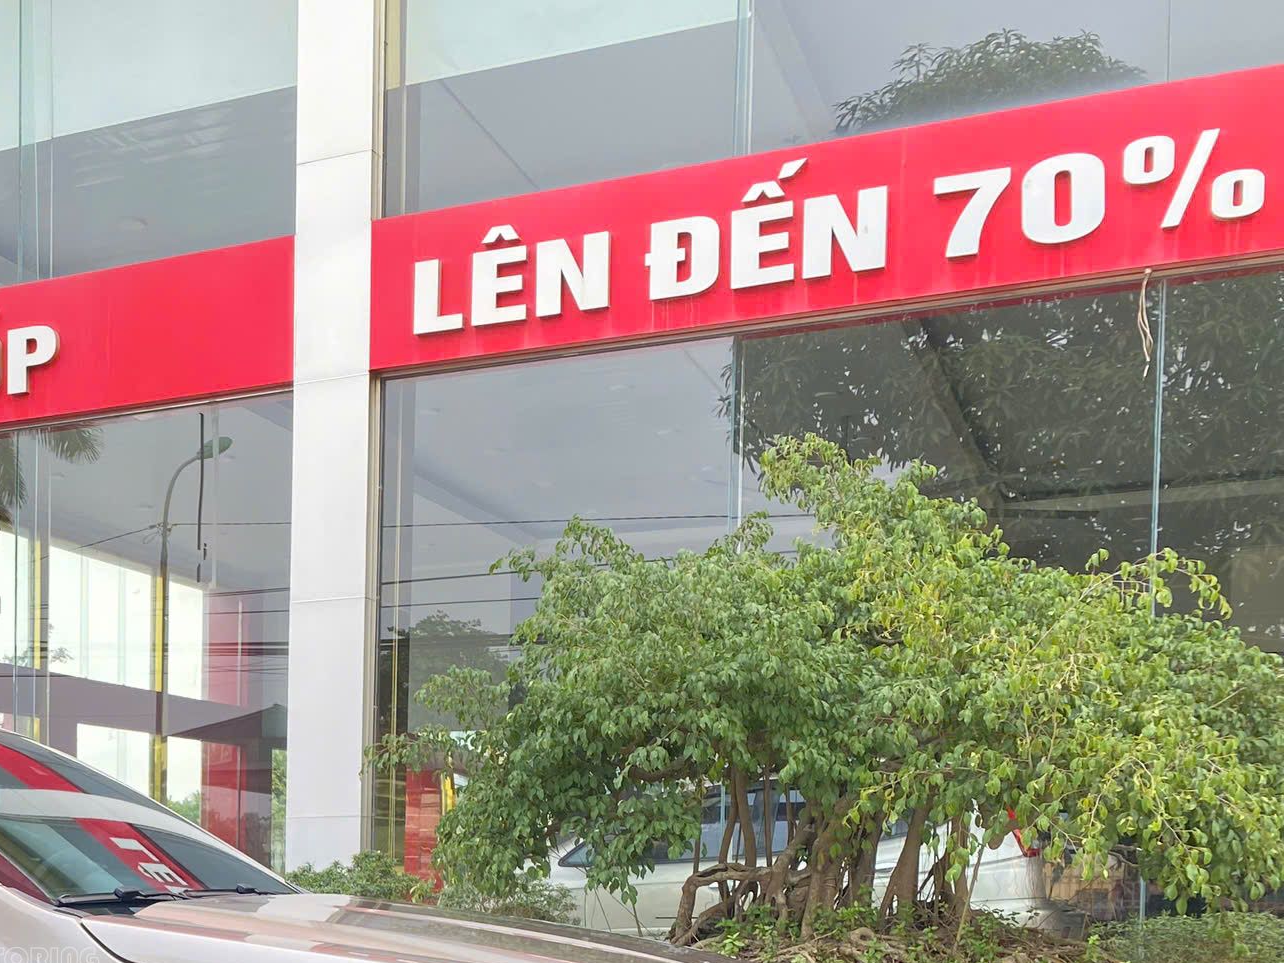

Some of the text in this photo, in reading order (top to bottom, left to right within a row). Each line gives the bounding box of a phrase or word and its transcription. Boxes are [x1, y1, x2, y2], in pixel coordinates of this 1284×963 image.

[412, 128, 1266, 336] LÊN ĐẾN 70%
